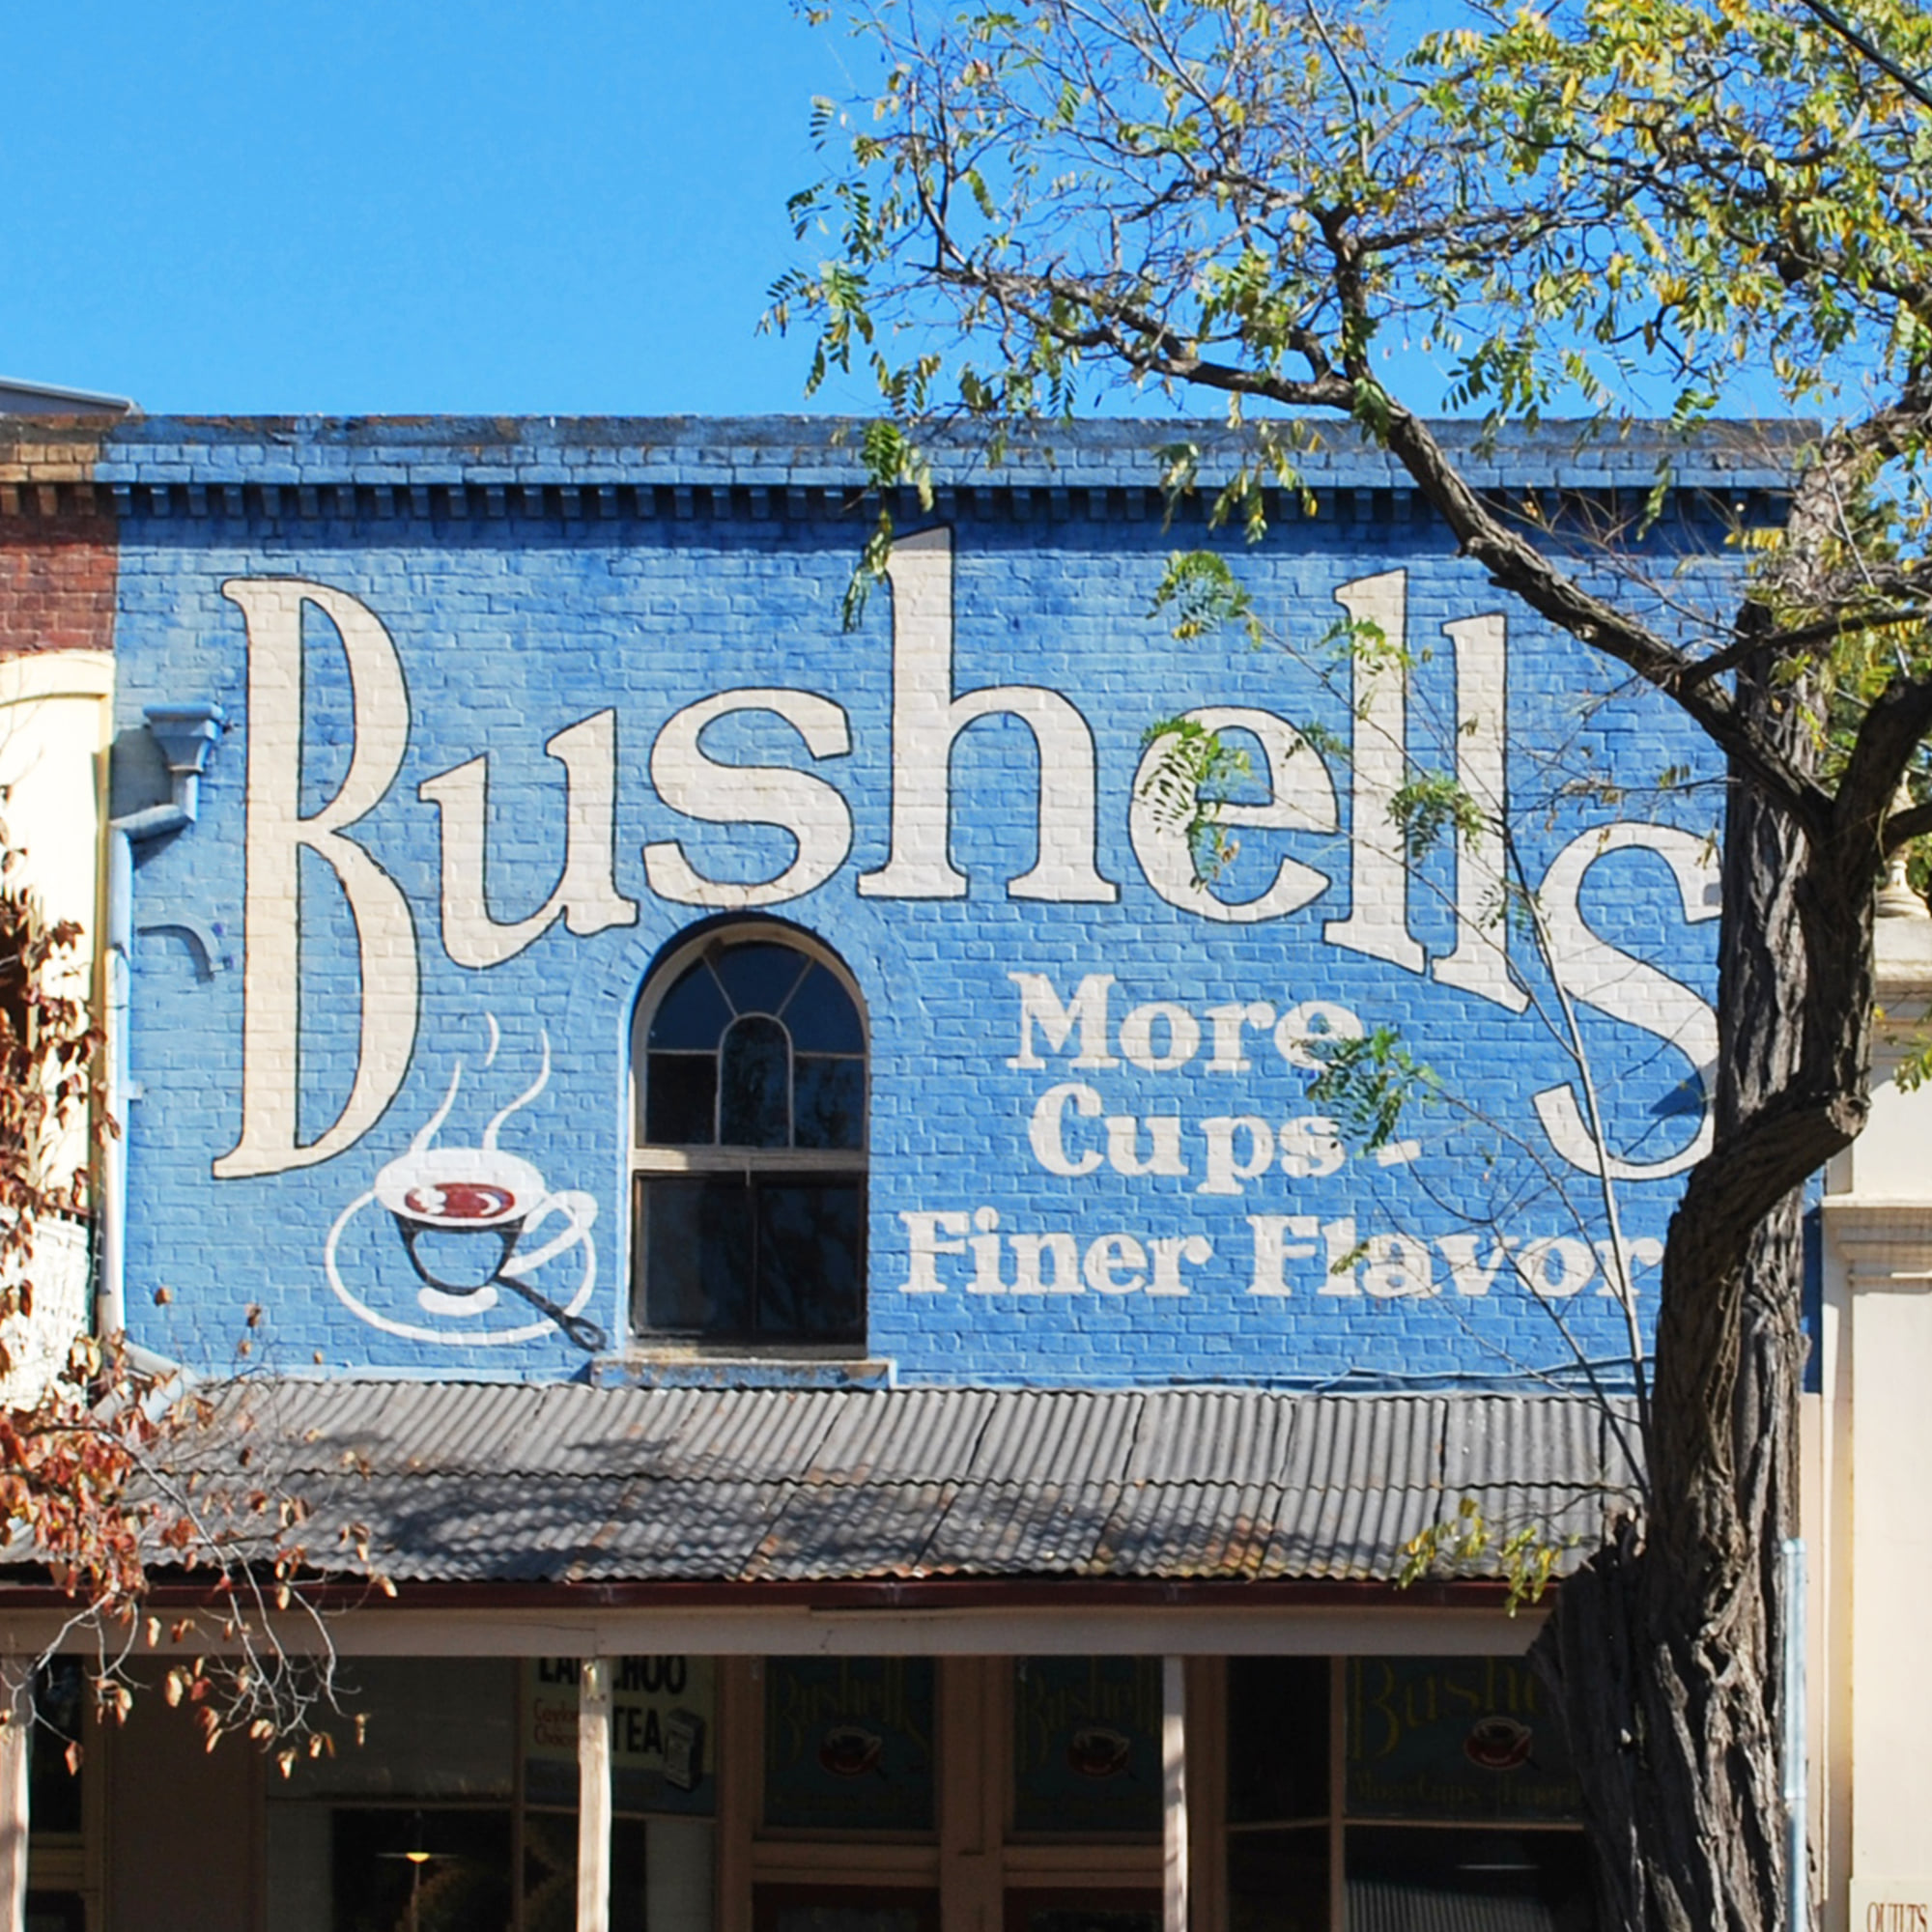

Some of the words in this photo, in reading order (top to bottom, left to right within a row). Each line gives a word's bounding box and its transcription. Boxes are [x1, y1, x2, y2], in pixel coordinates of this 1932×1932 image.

[213, 525, 1722, 1181] Bushells
[1006, 972, 1365, 1071] More
[1028, 1082, 1346, 1196] Cups
[898, 1206, 1213, 1297] Finer
[1246, 1214, 1665, 1299] Flavor
[611, 1705, 664, 1755] TEA
